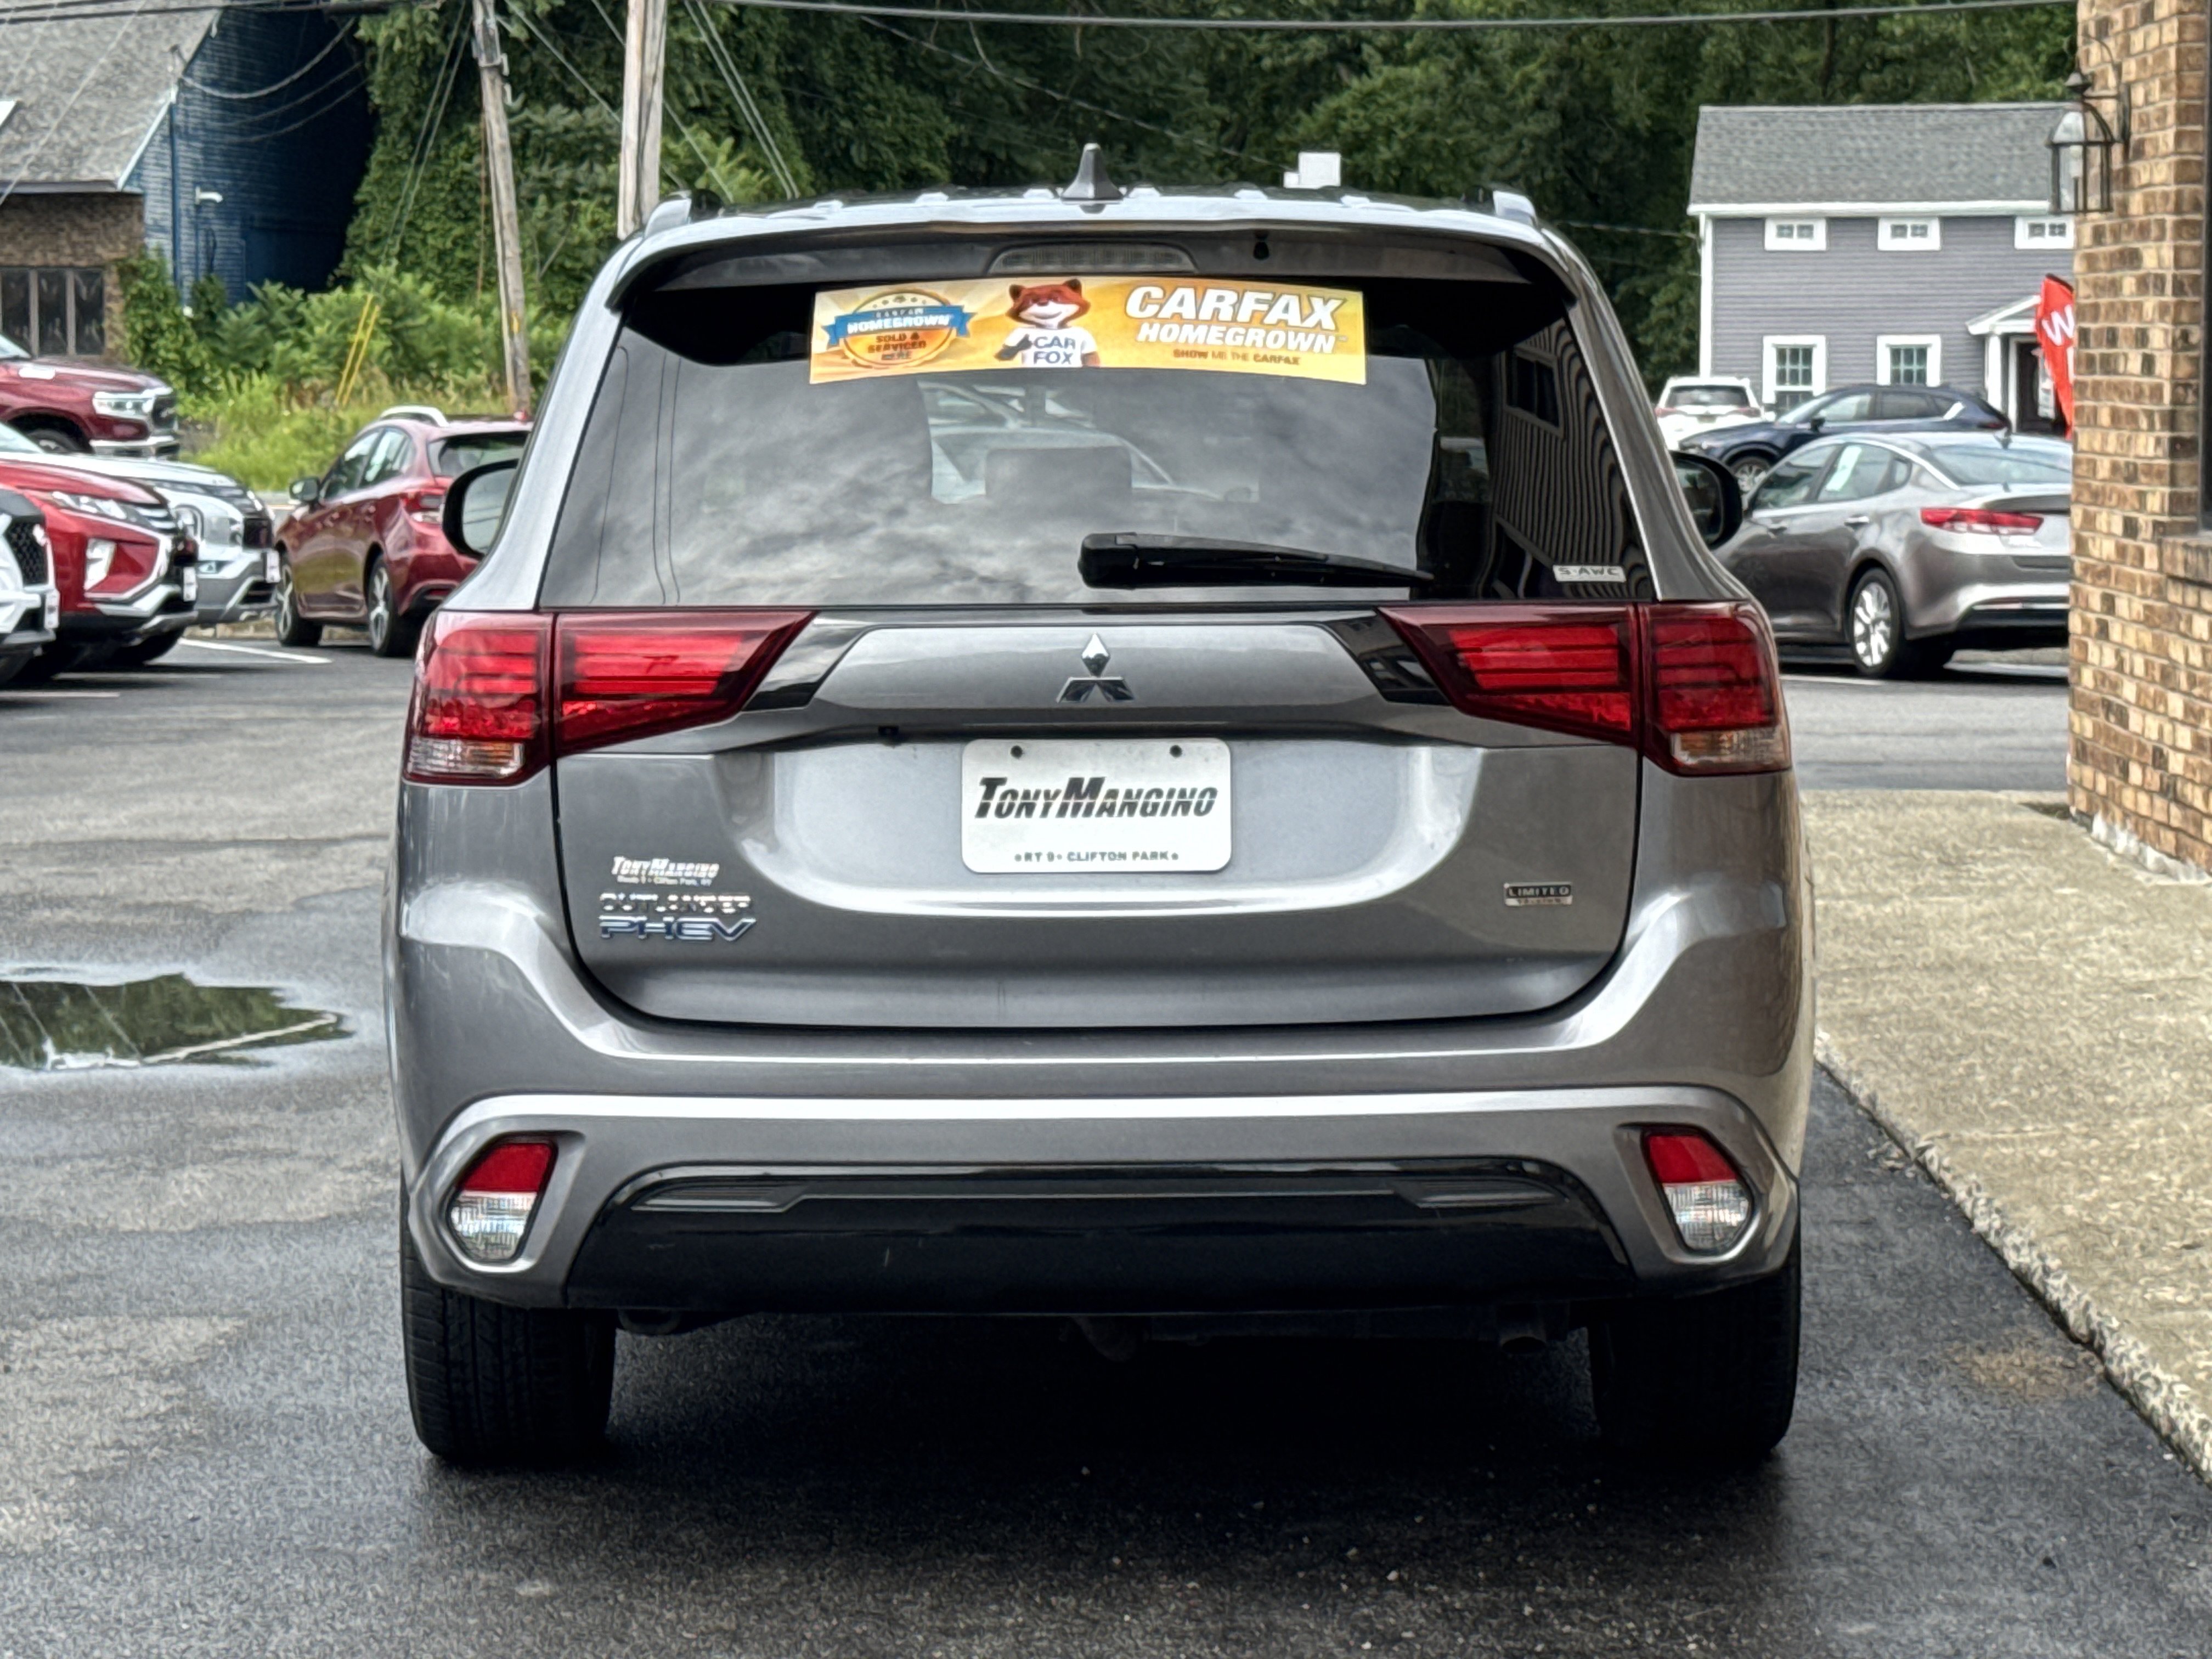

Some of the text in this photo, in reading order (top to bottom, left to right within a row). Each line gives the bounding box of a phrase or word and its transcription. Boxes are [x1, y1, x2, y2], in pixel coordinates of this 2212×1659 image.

[1125, 285, 1344, 330] CARFAX
[847, 314, 950, 334] HOMEGROWN
[876, 332, 907, 343] SOLD
[1034, 336, 1076, 349] CAR
[1136, 322, 1335, 354] HOMEGROWN
[1034, 351, 1074, 365] FOX
[1173, 349, 1209, 359] SHOW
[1253, 353, 1300, 365] CARFAX
[1067, 851, 1127, 862] CLIFTON
[1132, 851, 1169, 861] PARK
[598, 915, 756, 941] PHEV
